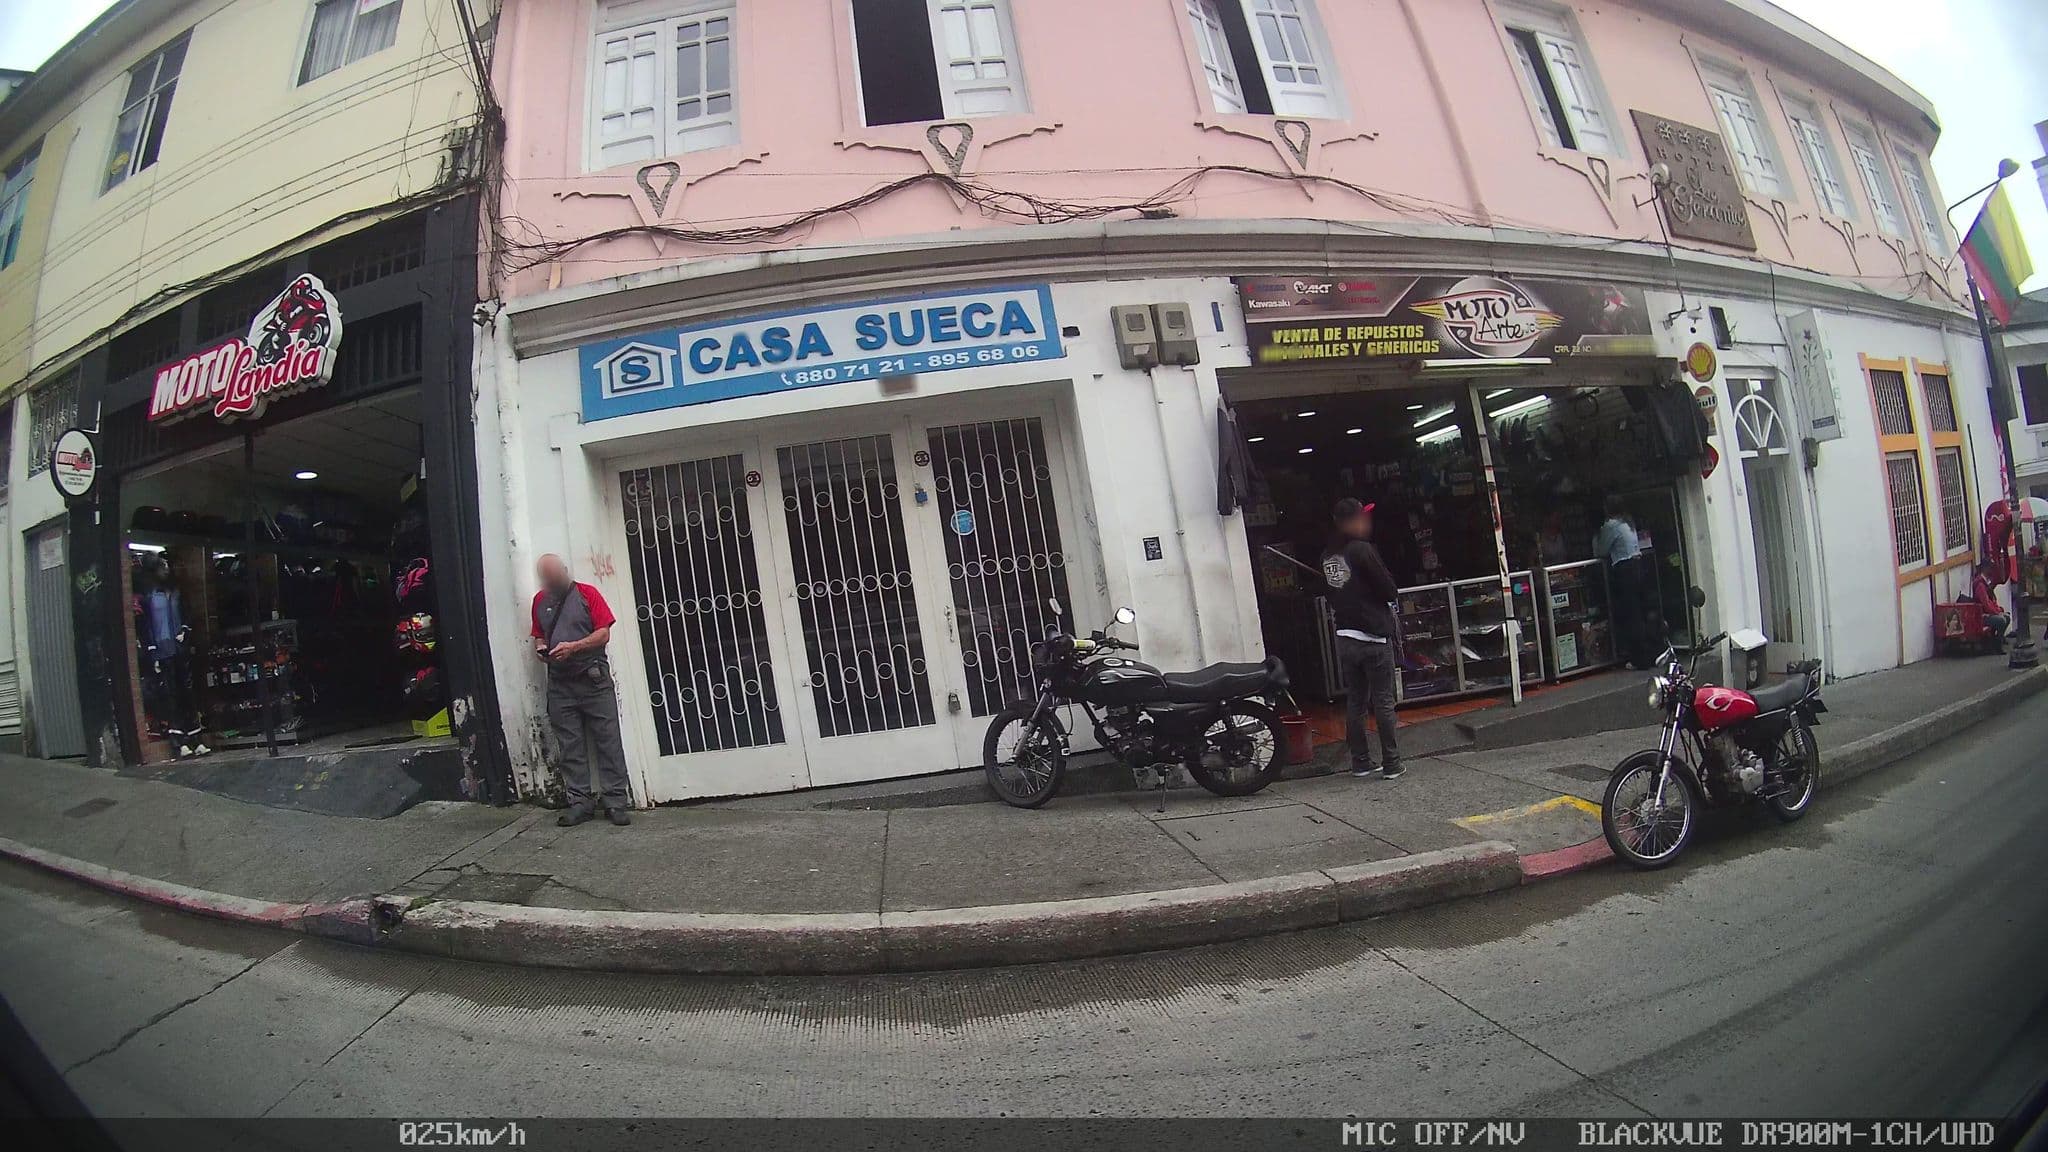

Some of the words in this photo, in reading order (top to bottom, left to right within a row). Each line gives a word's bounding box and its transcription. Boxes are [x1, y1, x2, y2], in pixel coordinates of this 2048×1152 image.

[1248, 299, 1290, 309] Kawasaki
[1305, 284, 1332, 294] AKT
[1444, 297, 1509, 320] MOTO
[1478, 316, 1524, 339] Arte
[689, 322, 834, 374] CASA
[855, 300, 1036, 351] SUECA
[1273, 328, 1319, 344] VENTA
[1324, 327, 1342, 341] DE
[1347, 325, 1424, 340] REPUESTOS
[796, 368, 836, 384] 880
[844, 363, 869, 377] 71
[879, 359, 905, 373] 21
[928, 351, 970, 367] 895
[977, 348, 1005, 361] 68
[1011, 345, 1039, 358] 06
[1262, 343, 1349, 361] INALES
[1353, 342, 1361, 356] Y
[1368, 340, 1440, 356] GENERICOS
[151, 343, 237, 416] MOTO
[216, 340, 322, 416] Landia
